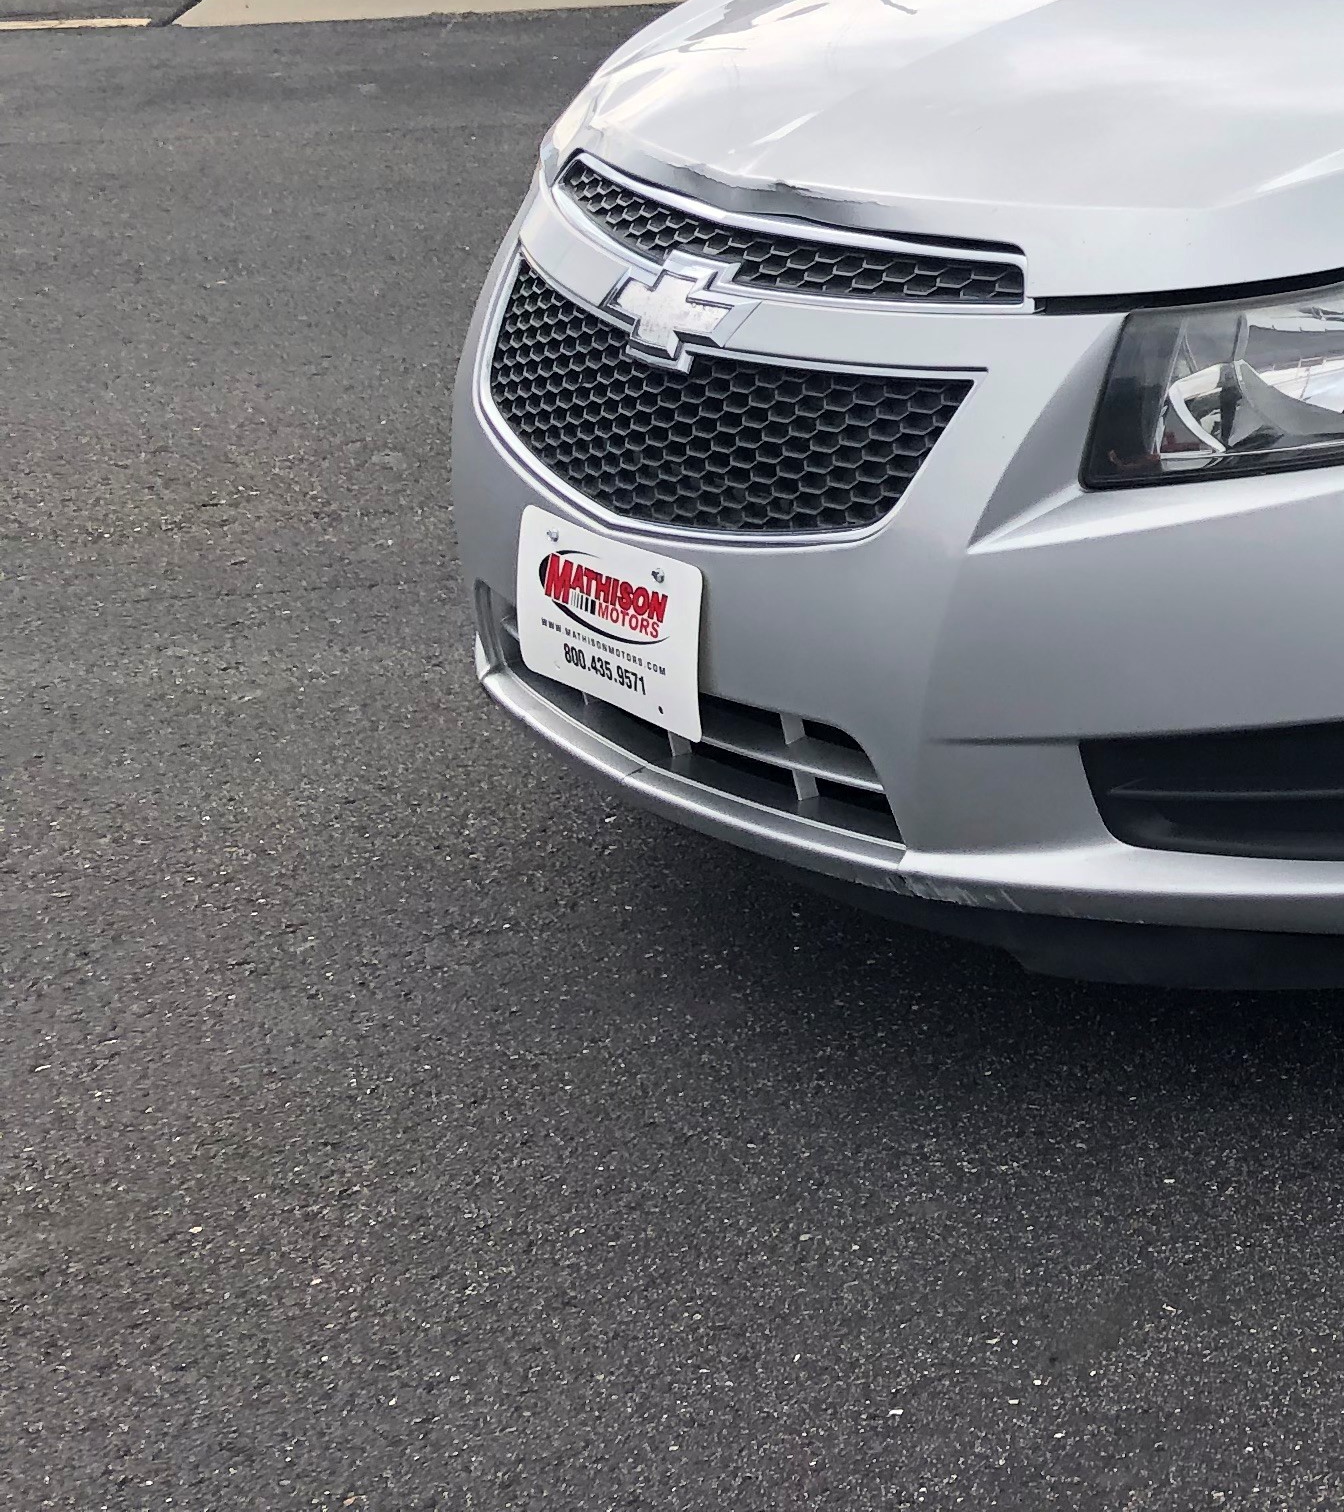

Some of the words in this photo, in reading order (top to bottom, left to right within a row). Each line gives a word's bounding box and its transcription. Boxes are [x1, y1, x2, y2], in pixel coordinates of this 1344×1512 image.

[545, 553, 669, 623] MATHISON
[597, 602, 660, 639] MOTORS
[563, 642, 647, 696] 800.435.9571
